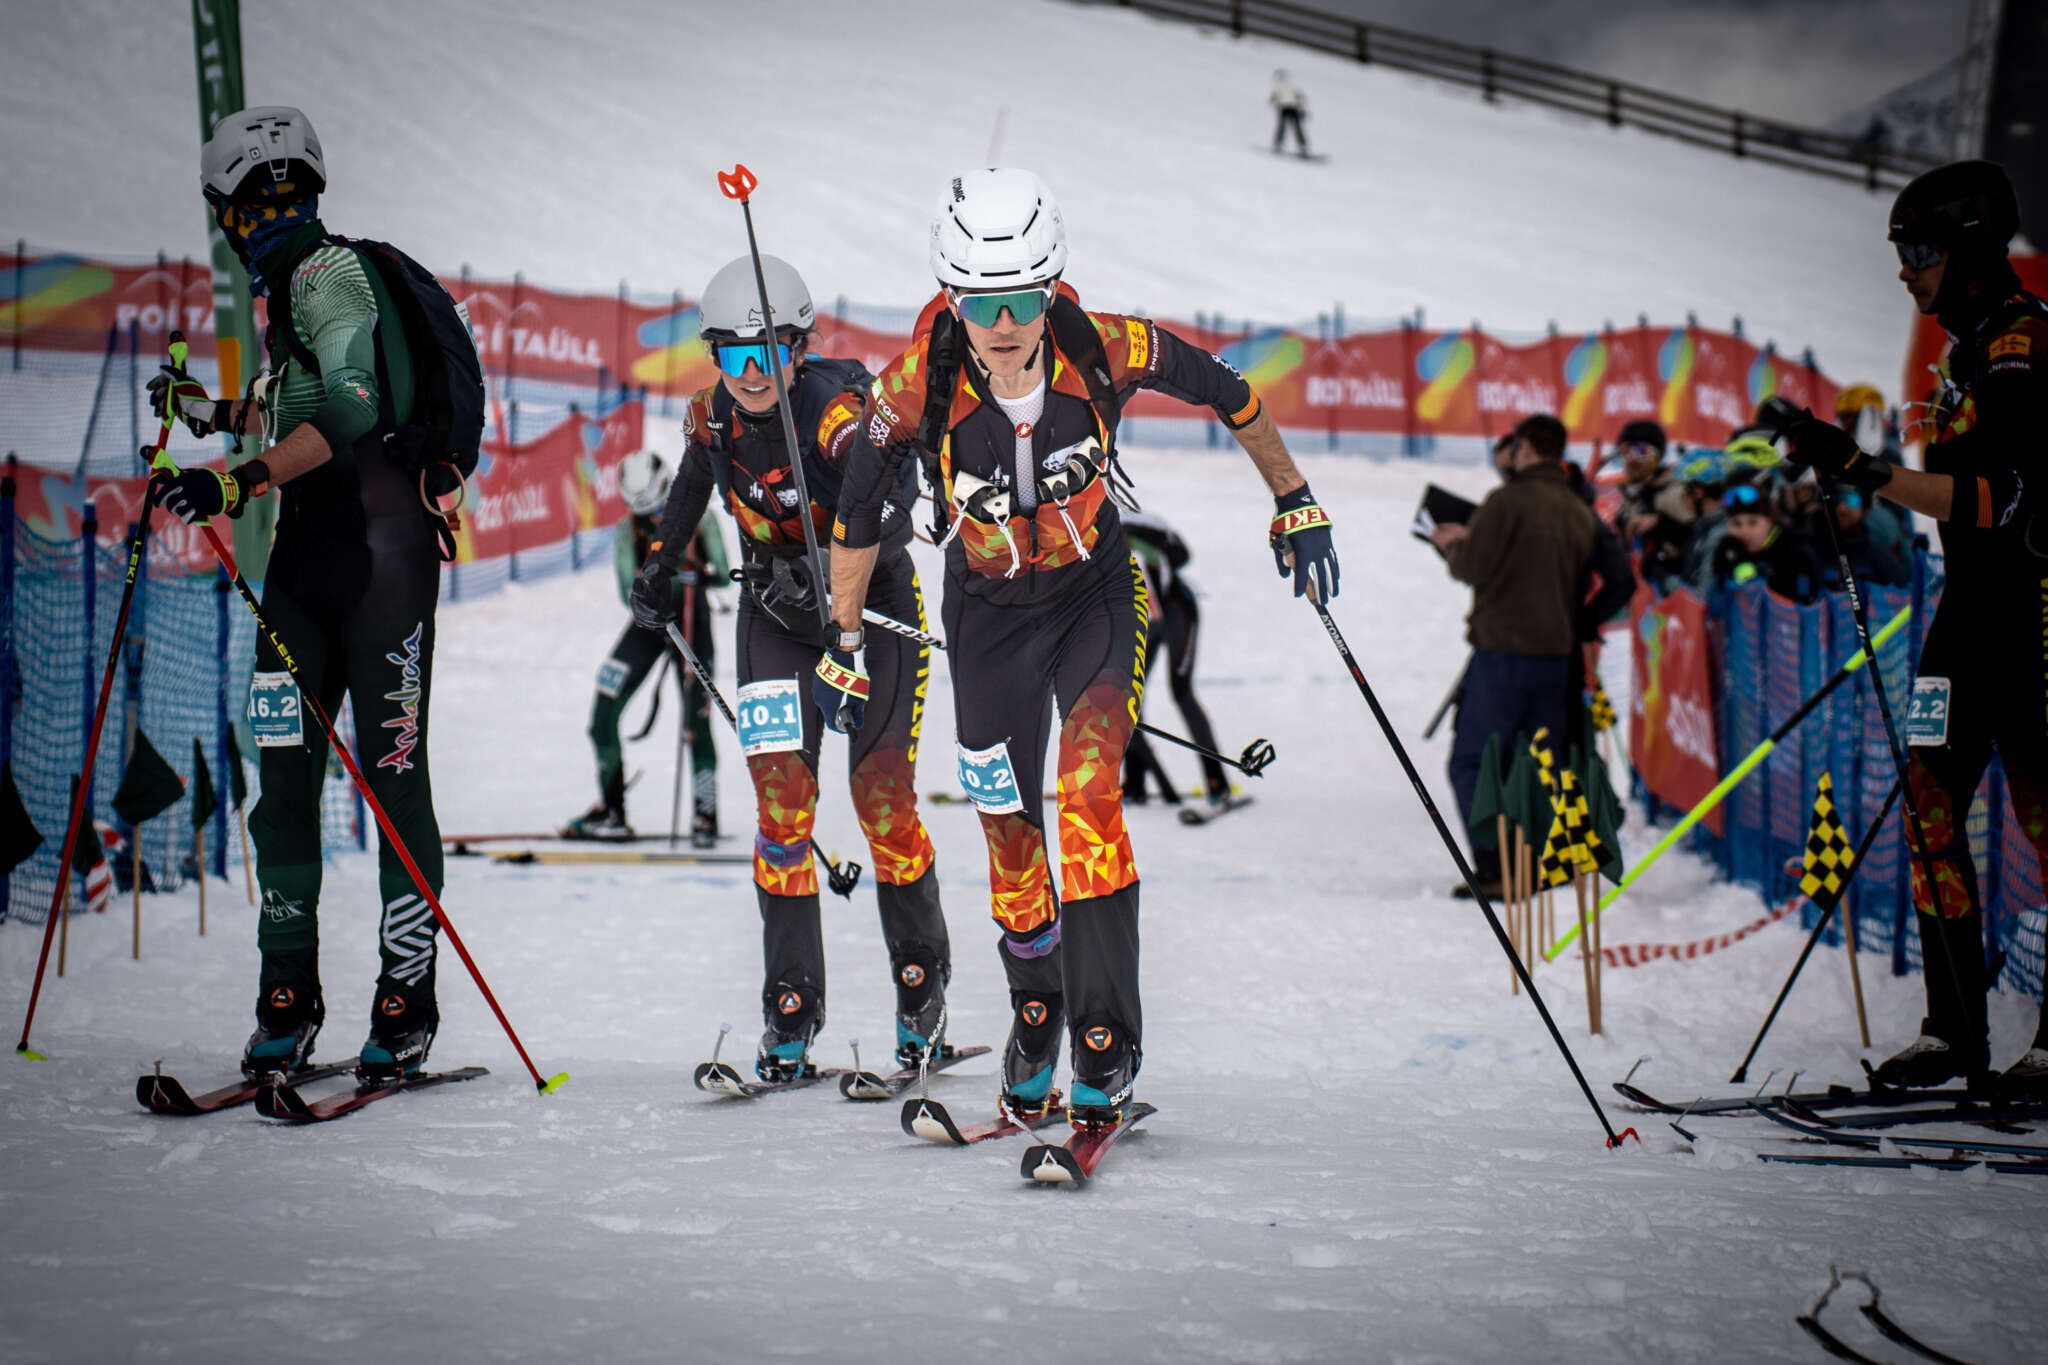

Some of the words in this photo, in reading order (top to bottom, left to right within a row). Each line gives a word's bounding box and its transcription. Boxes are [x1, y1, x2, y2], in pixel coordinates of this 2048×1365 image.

[269, 631, 299, 674] LEKI
[1320, 614, 1349, 656] ATOMIC
[740, 702, 798, 730] 10.1
